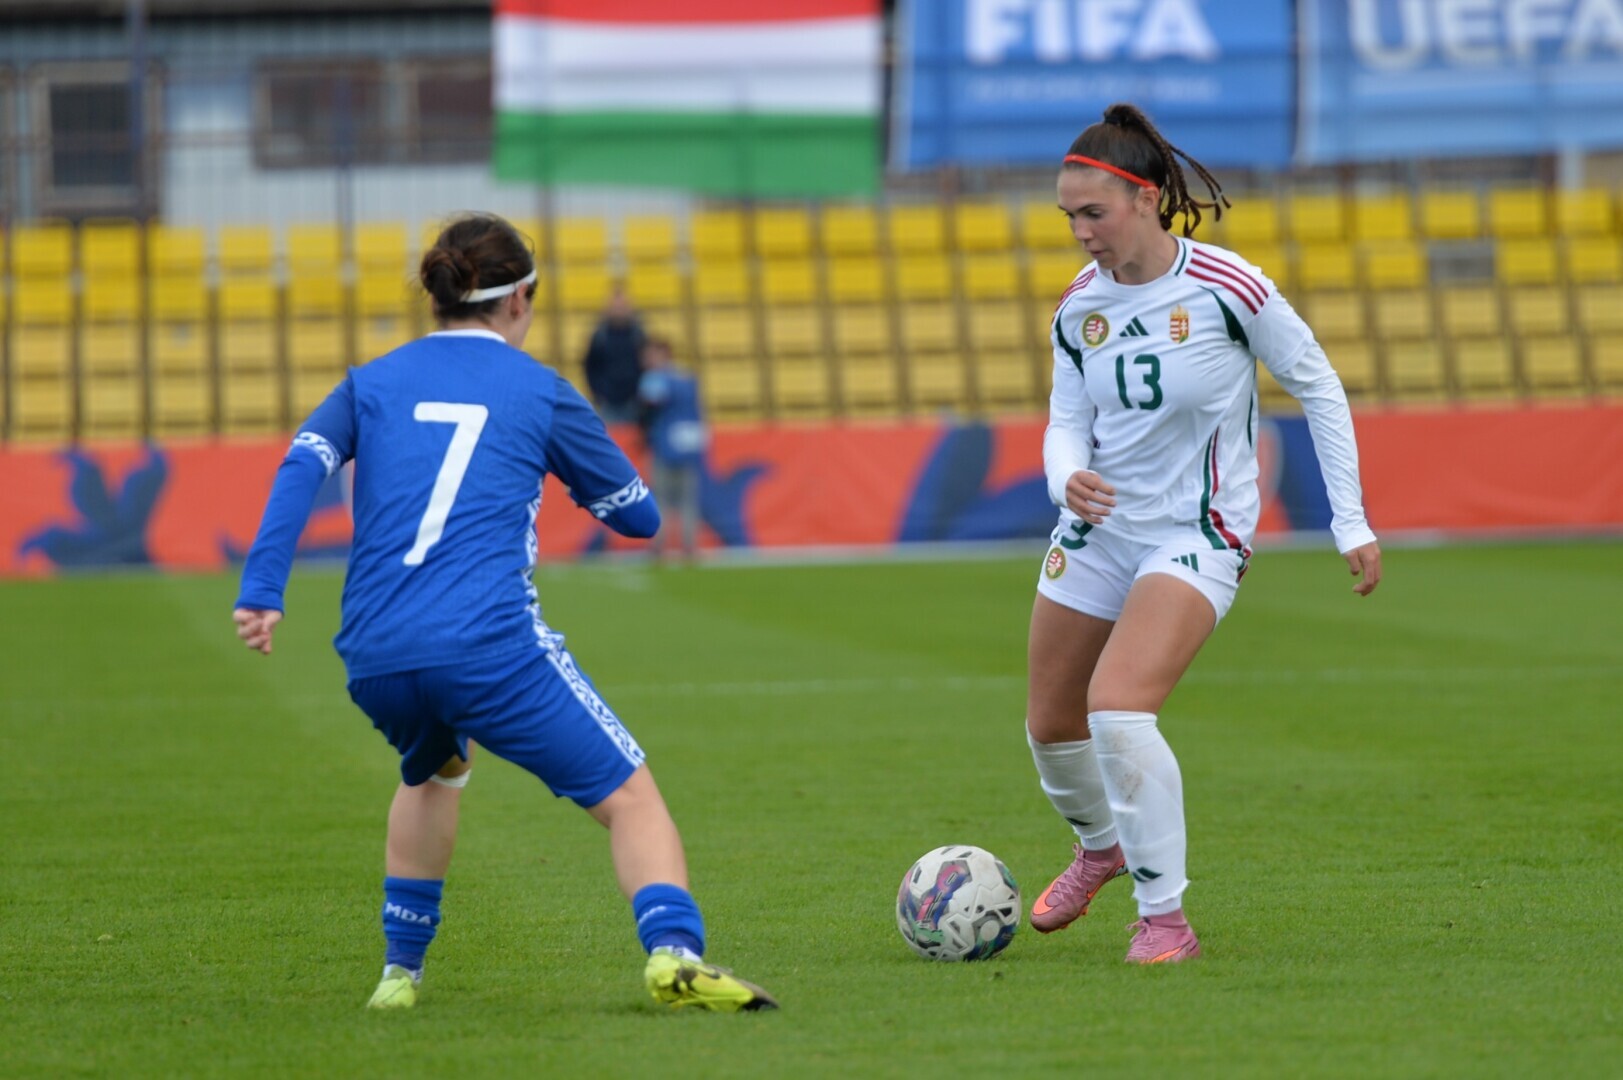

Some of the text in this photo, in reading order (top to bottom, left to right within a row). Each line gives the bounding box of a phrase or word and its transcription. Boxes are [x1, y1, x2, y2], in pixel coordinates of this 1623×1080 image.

[966, 0, 1219, 61] FIFA
[1351, 0, 1623, 69] UEFA
[1115, 354, 1163, 410] 13
[403, 402, 488, 565] 7
[386, 902, 431, 925] MDA
